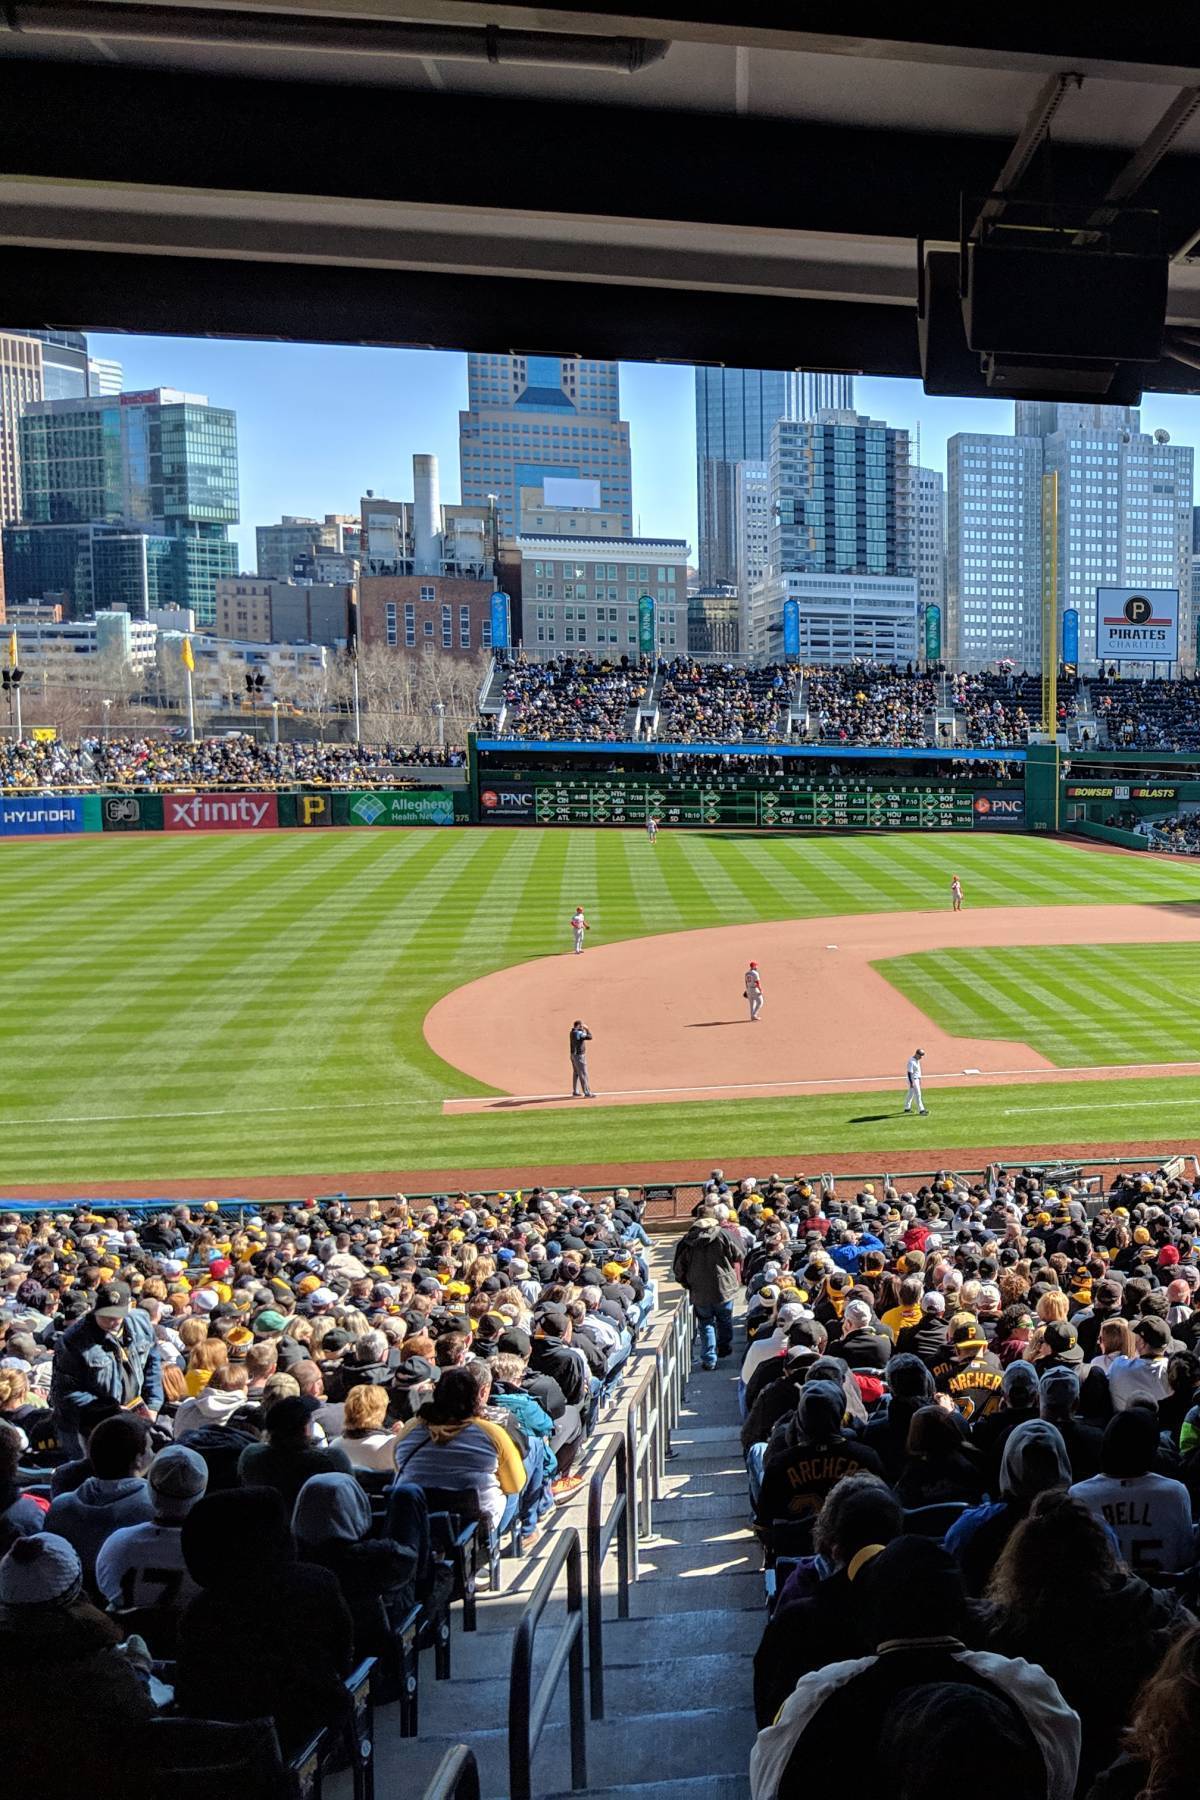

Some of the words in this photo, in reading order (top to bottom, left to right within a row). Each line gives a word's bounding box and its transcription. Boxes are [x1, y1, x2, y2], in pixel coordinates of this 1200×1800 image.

[1132, 602, 1145, 620] P
[1109, 629, 1166, 640] PIRATES
[1108, 640, 1167, 649] CHARITIES
[555, 781, 651, 789] NATIONAL
[1074, 788, 1113, 796] BOWSER
[1139, 789, 1175, 797] BLASTS
[499, 793, 532, 806] PNC
[303, 796, 326, 825] P
[391, 799, 451, 813] Allegheny
[992, 800, 1023, 812] PNC
[4, 809, 75, 823] HYUNDAI
[172, 797, 269, 828] xfinity
[391, 813, 418, 821] Health
[455, 814, 470, 822] 375
[968, 1327, 976, 1338] P
[1069, 1337, 1076, 1348] P
[948, 1372, 1003, 1393] ARCHER
[786, 1456, 860, 1489] ARCHER
[1102, 1501, 1152, 1526] BELL
[121, 1567, 183, 1609] 17
